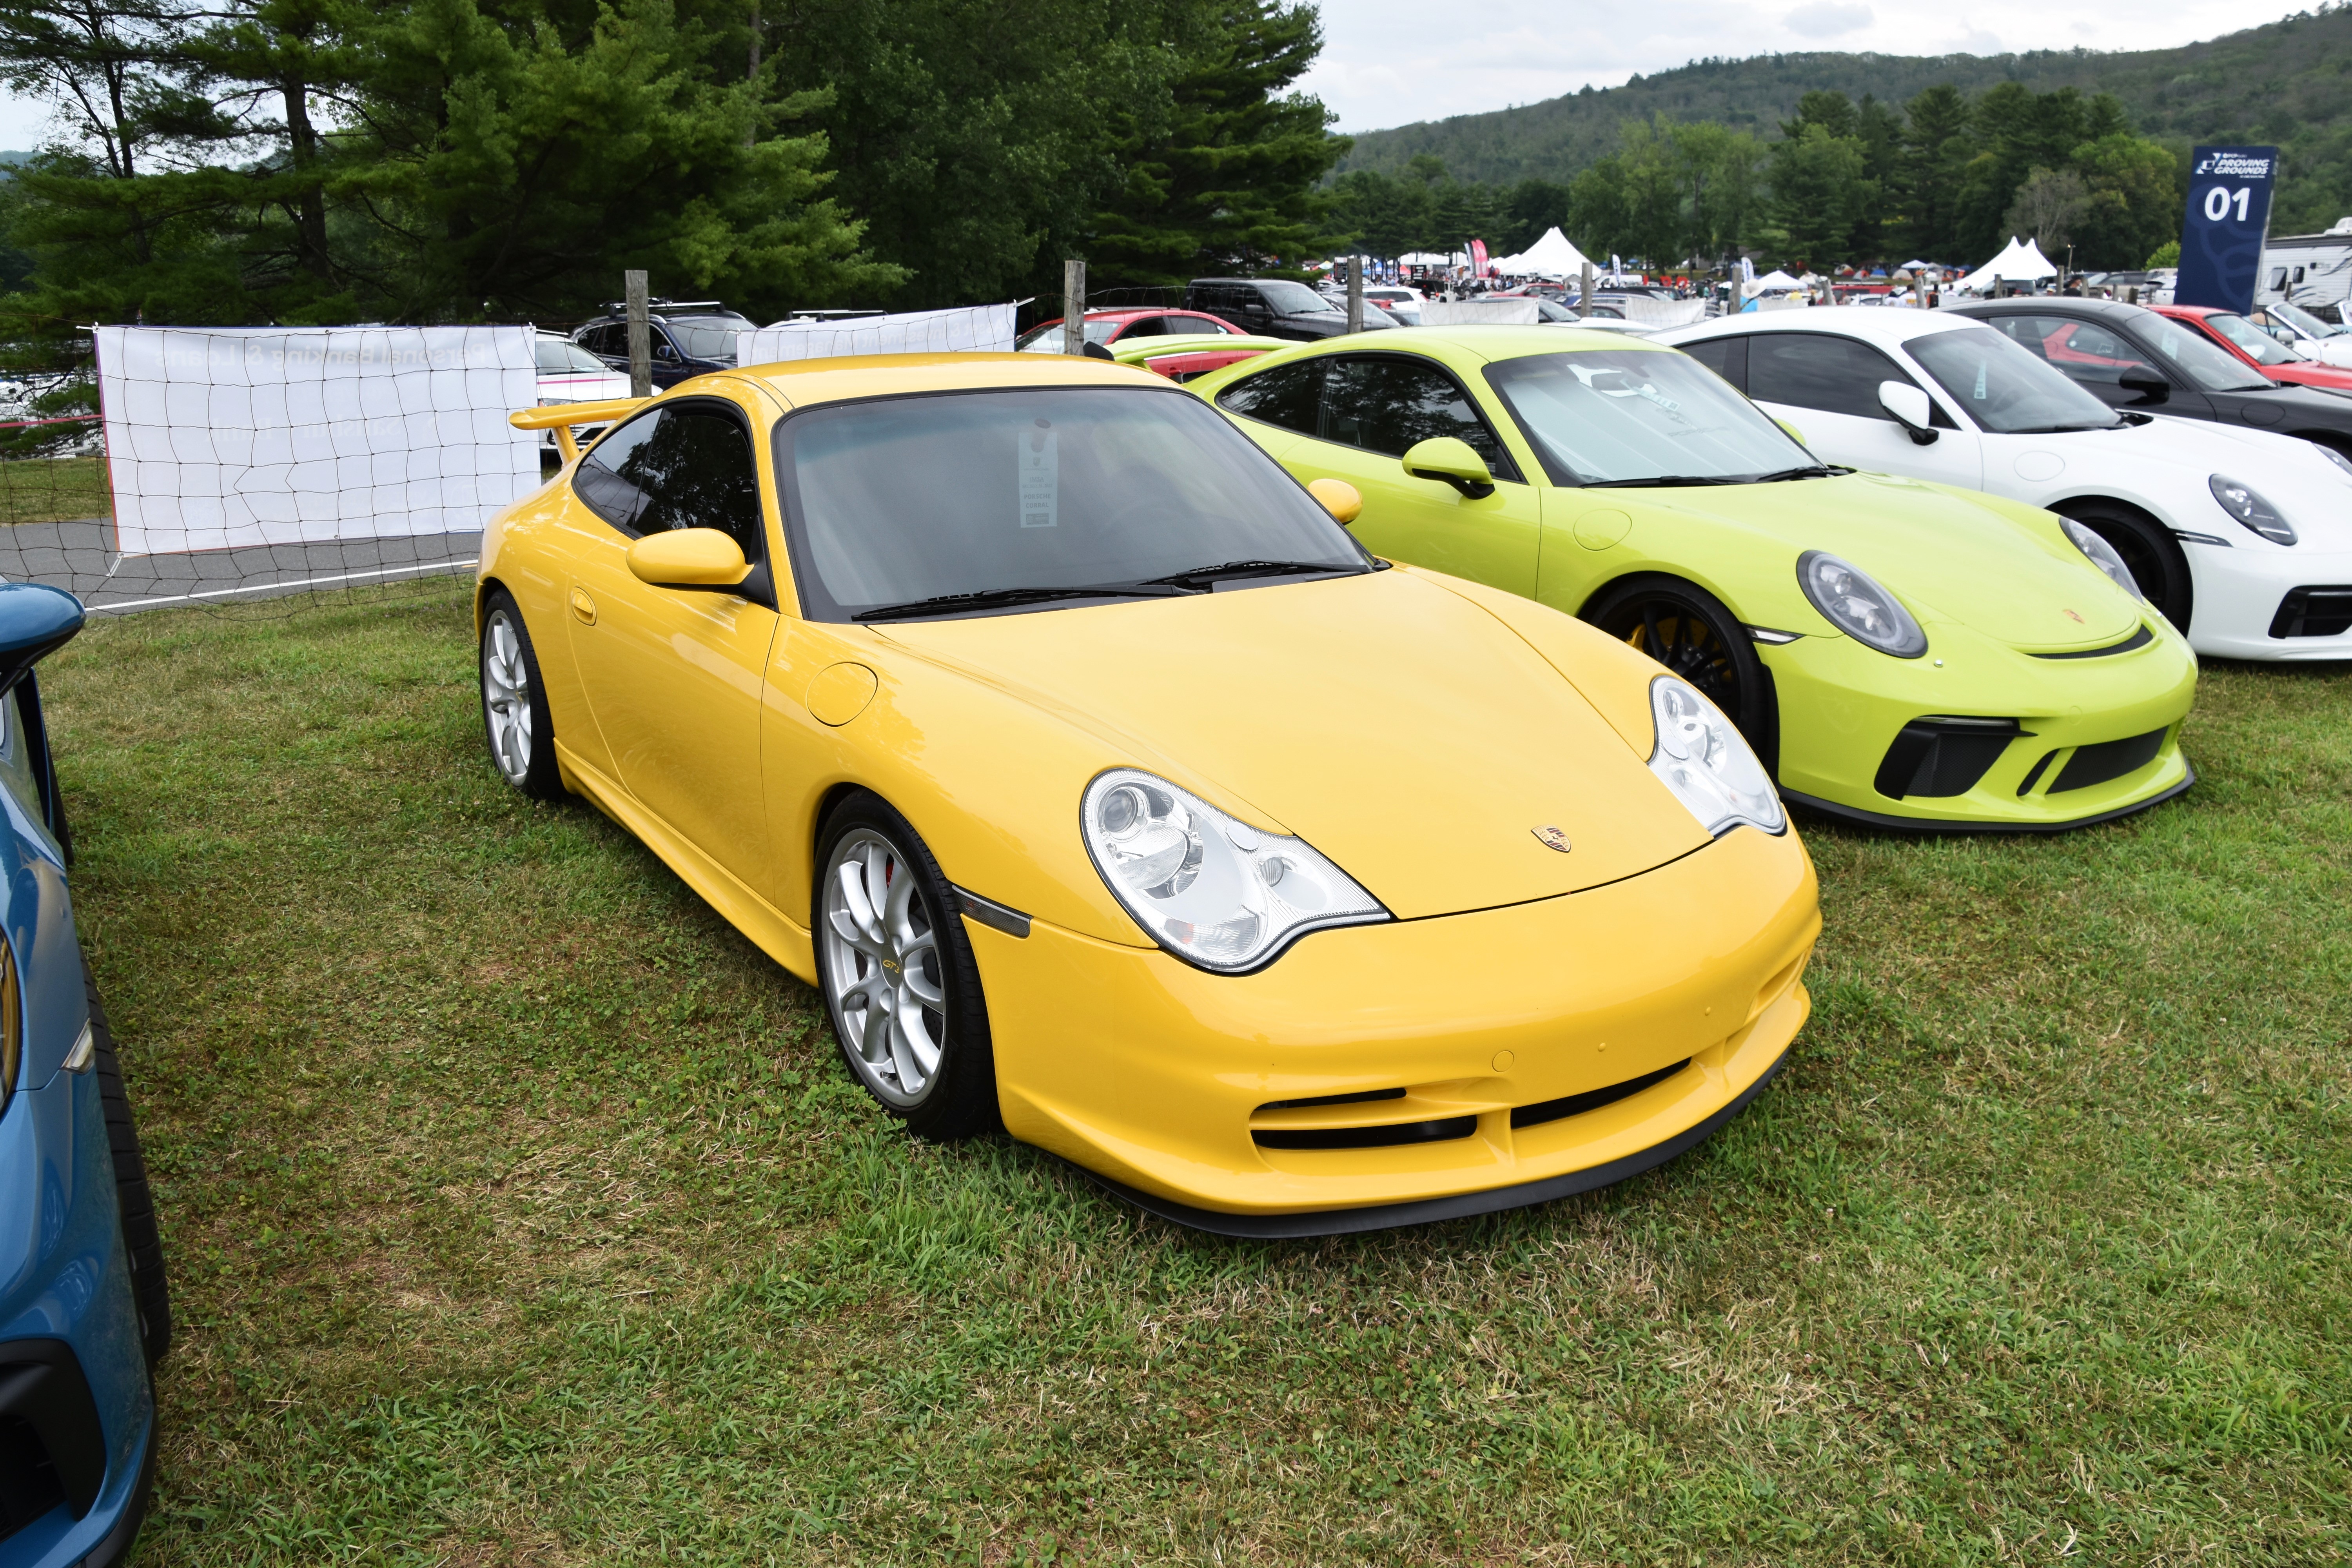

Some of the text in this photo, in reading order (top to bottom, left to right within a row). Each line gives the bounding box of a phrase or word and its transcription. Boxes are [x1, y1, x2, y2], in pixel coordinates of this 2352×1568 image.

[2218, 159, 2270, 167] PROVING
[2205, 187, 2250, 221] 01
[883, 960, 899, 973] GT3
